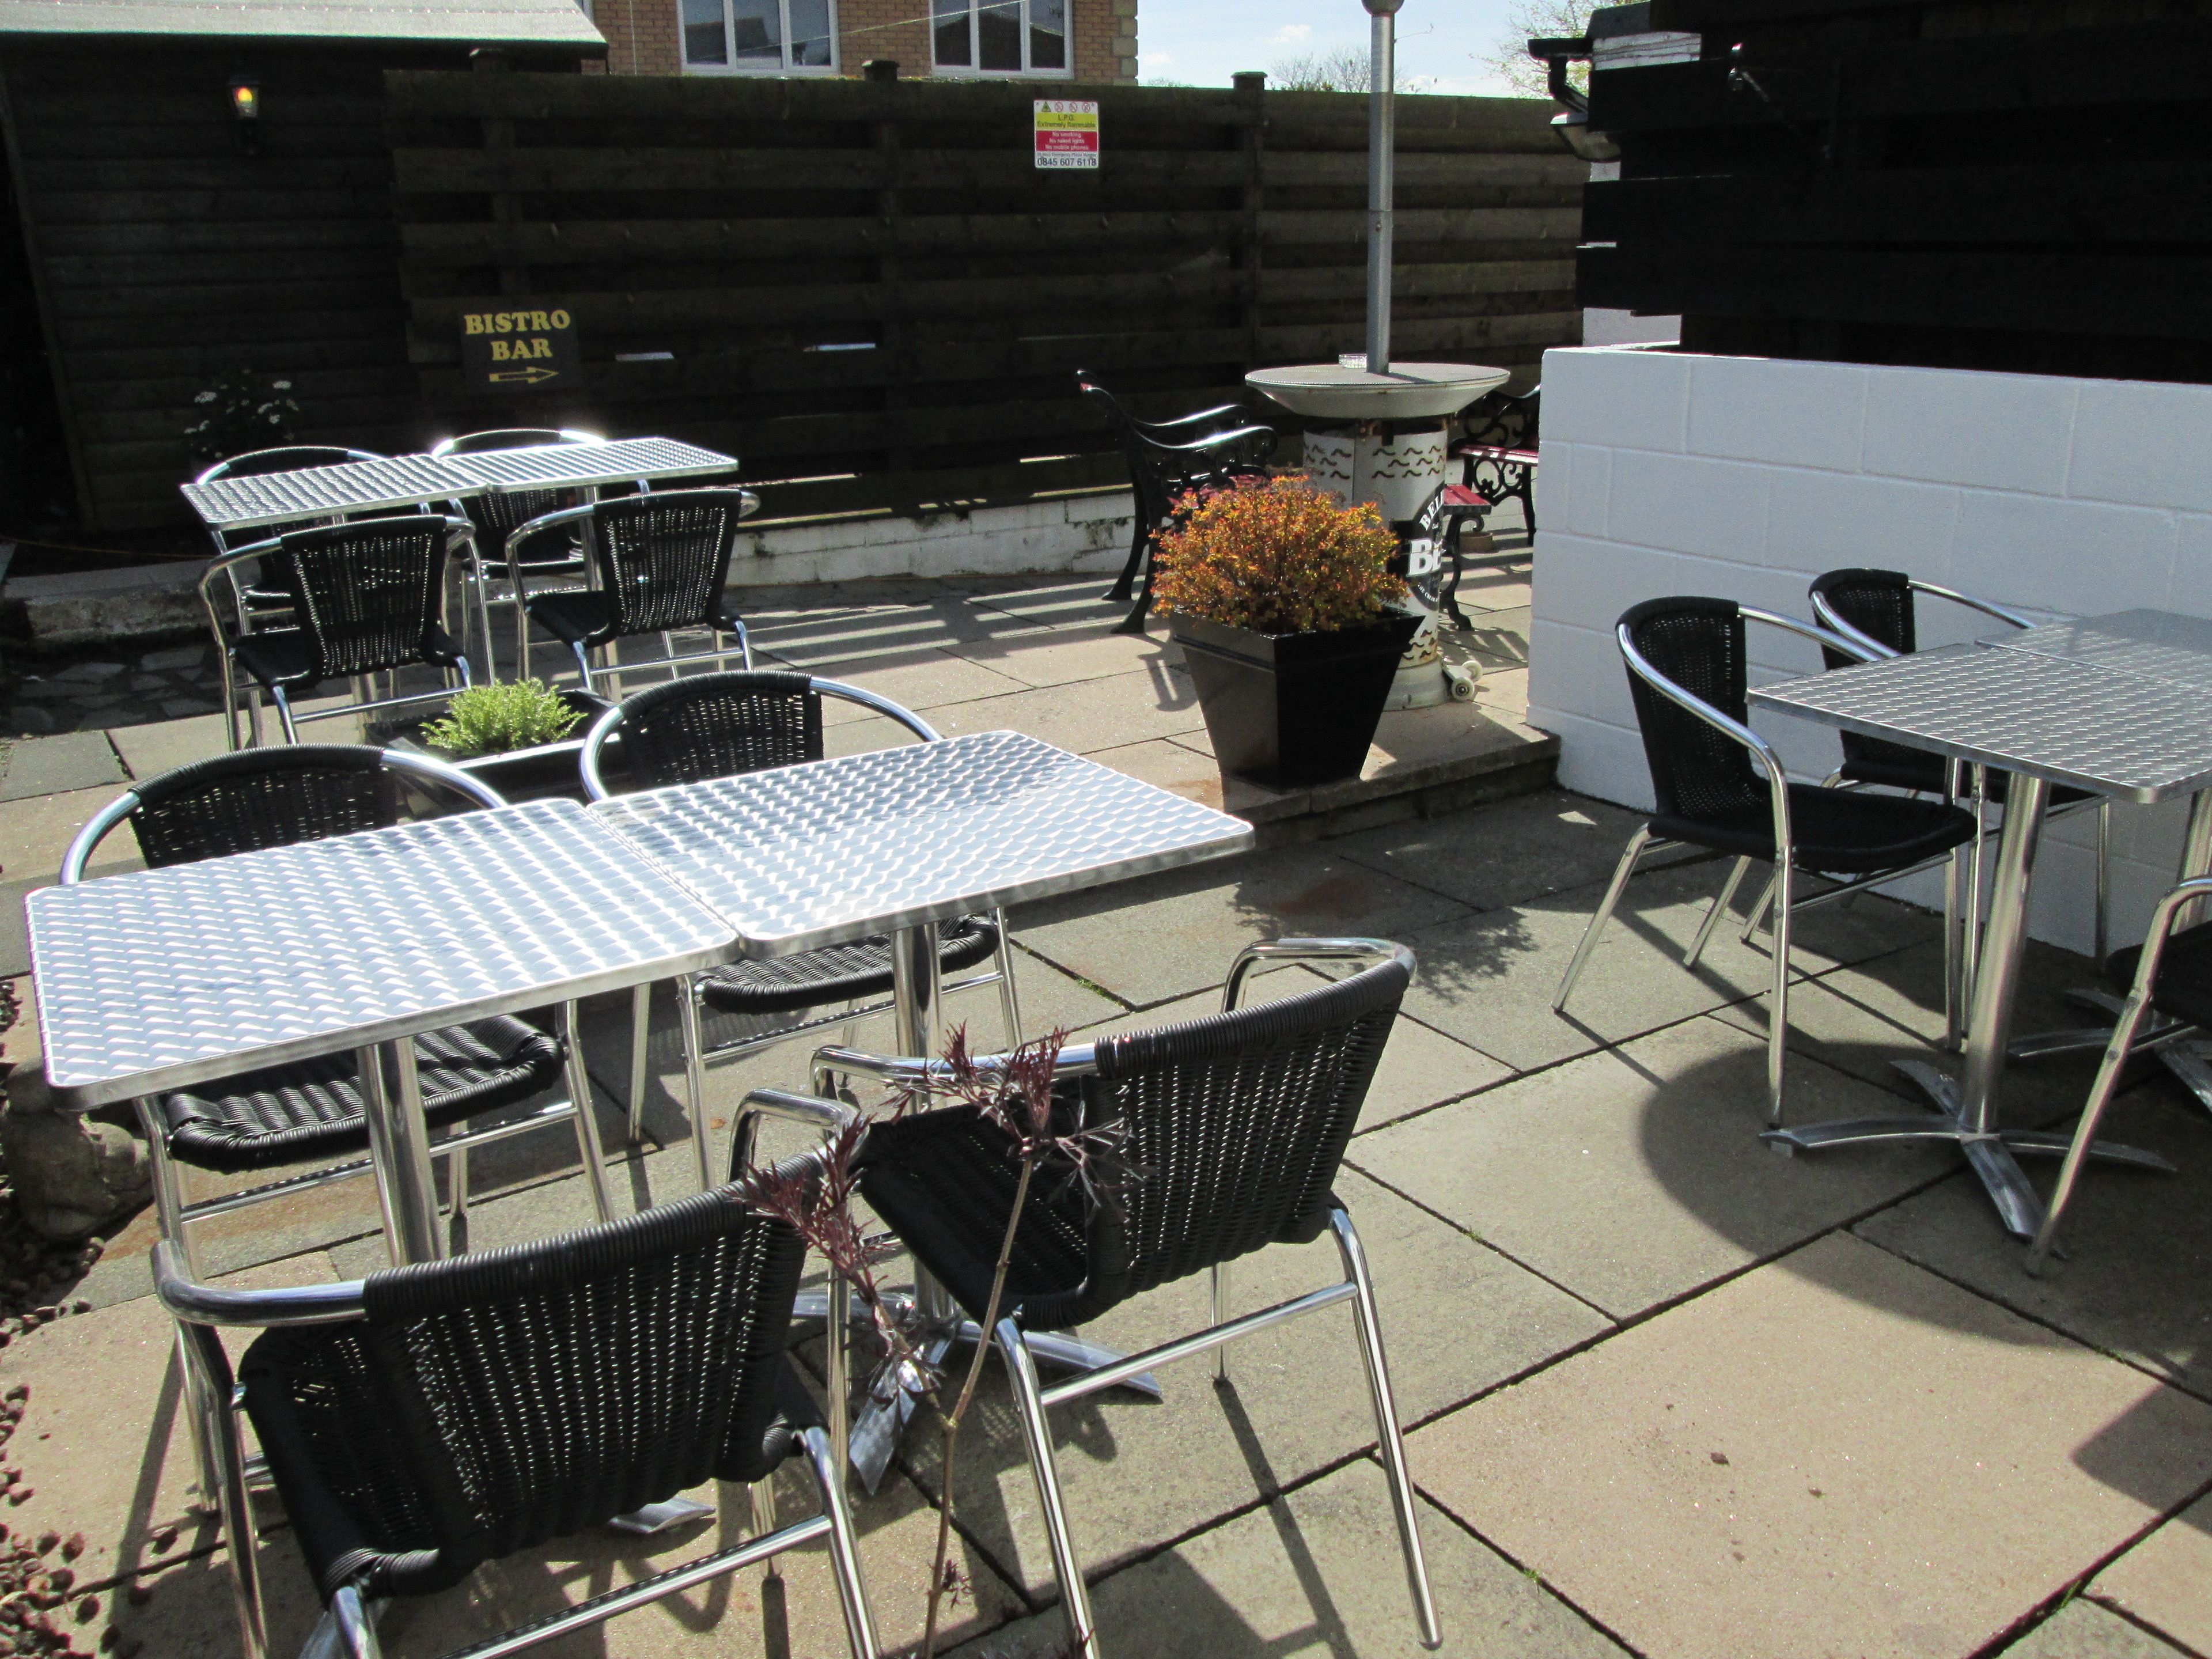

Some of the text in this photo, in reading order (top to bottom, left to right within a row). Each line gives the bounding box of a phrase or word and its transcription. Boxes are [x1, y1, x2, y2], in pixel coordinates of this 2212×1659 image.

[1037, 158, 1096, 166] 0845 607 6118
[464, 309, 571, 335] BISTRO
[490, 338, 554, 361] BAR
